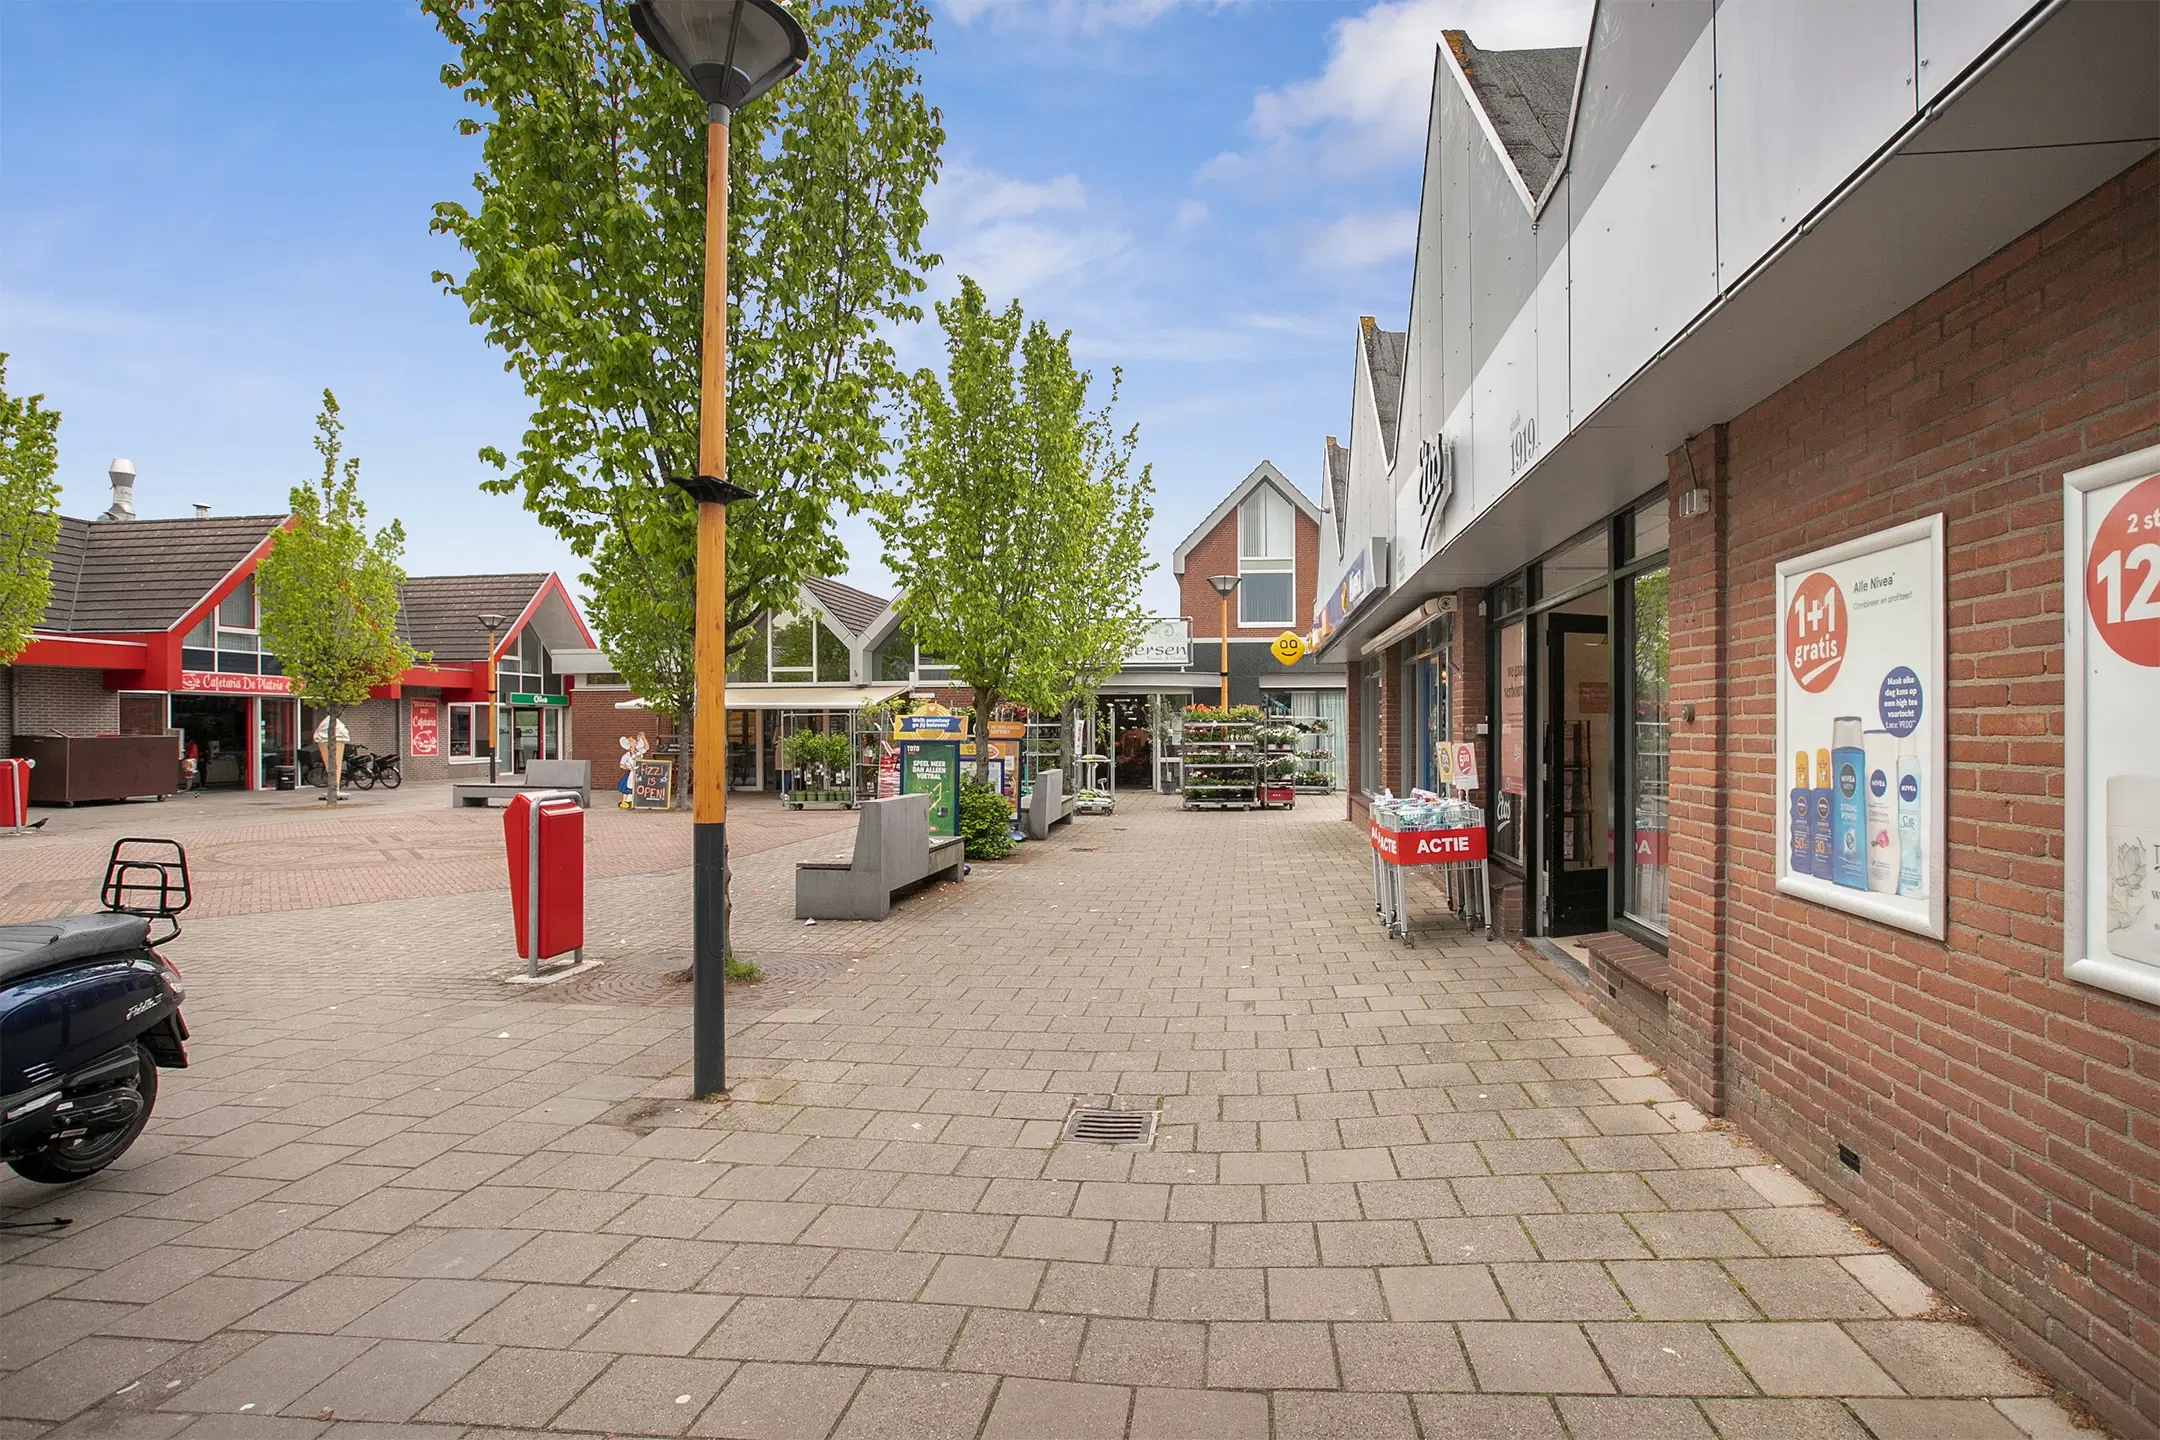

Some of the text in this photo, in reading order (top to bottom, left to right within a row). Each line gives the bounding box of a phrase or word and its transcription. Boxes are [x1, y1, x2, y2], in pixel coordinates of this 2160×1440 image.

[2127, 513, 2138, 533] 2
[1853, 581, 1868, 594] Alle
[2096, 543, 2160, 624] 12
[1853, 599, 1880, 611] Combineer
[1888, 591, 1913, 603] profiteer!
[1795, 586, 1835, 638] 1+1
[1122, 645, 1186, 657] etersen
[1794, 633, 1838, 668] gratis
[243, 676, 256, 690] De
[1887, 676, 1914, 685] Maak elke
[533, 695, 548, 703] Oliva
[1884, 689, 1895, 697] dag
[1909, 688, 1917, 696] op
[1896, 698, 1908, 708] high
[1887, 709, 1915, 718] vaartocht
[1841, 775, 1855, 783] NIVEA
[636, 785, 666, 800] OPEN!
[1497, 790, 1511, 827] Etos
[1380, 835, 1397, 855] ACTIE
[1417, 836, 1470, 854] ACTIE
